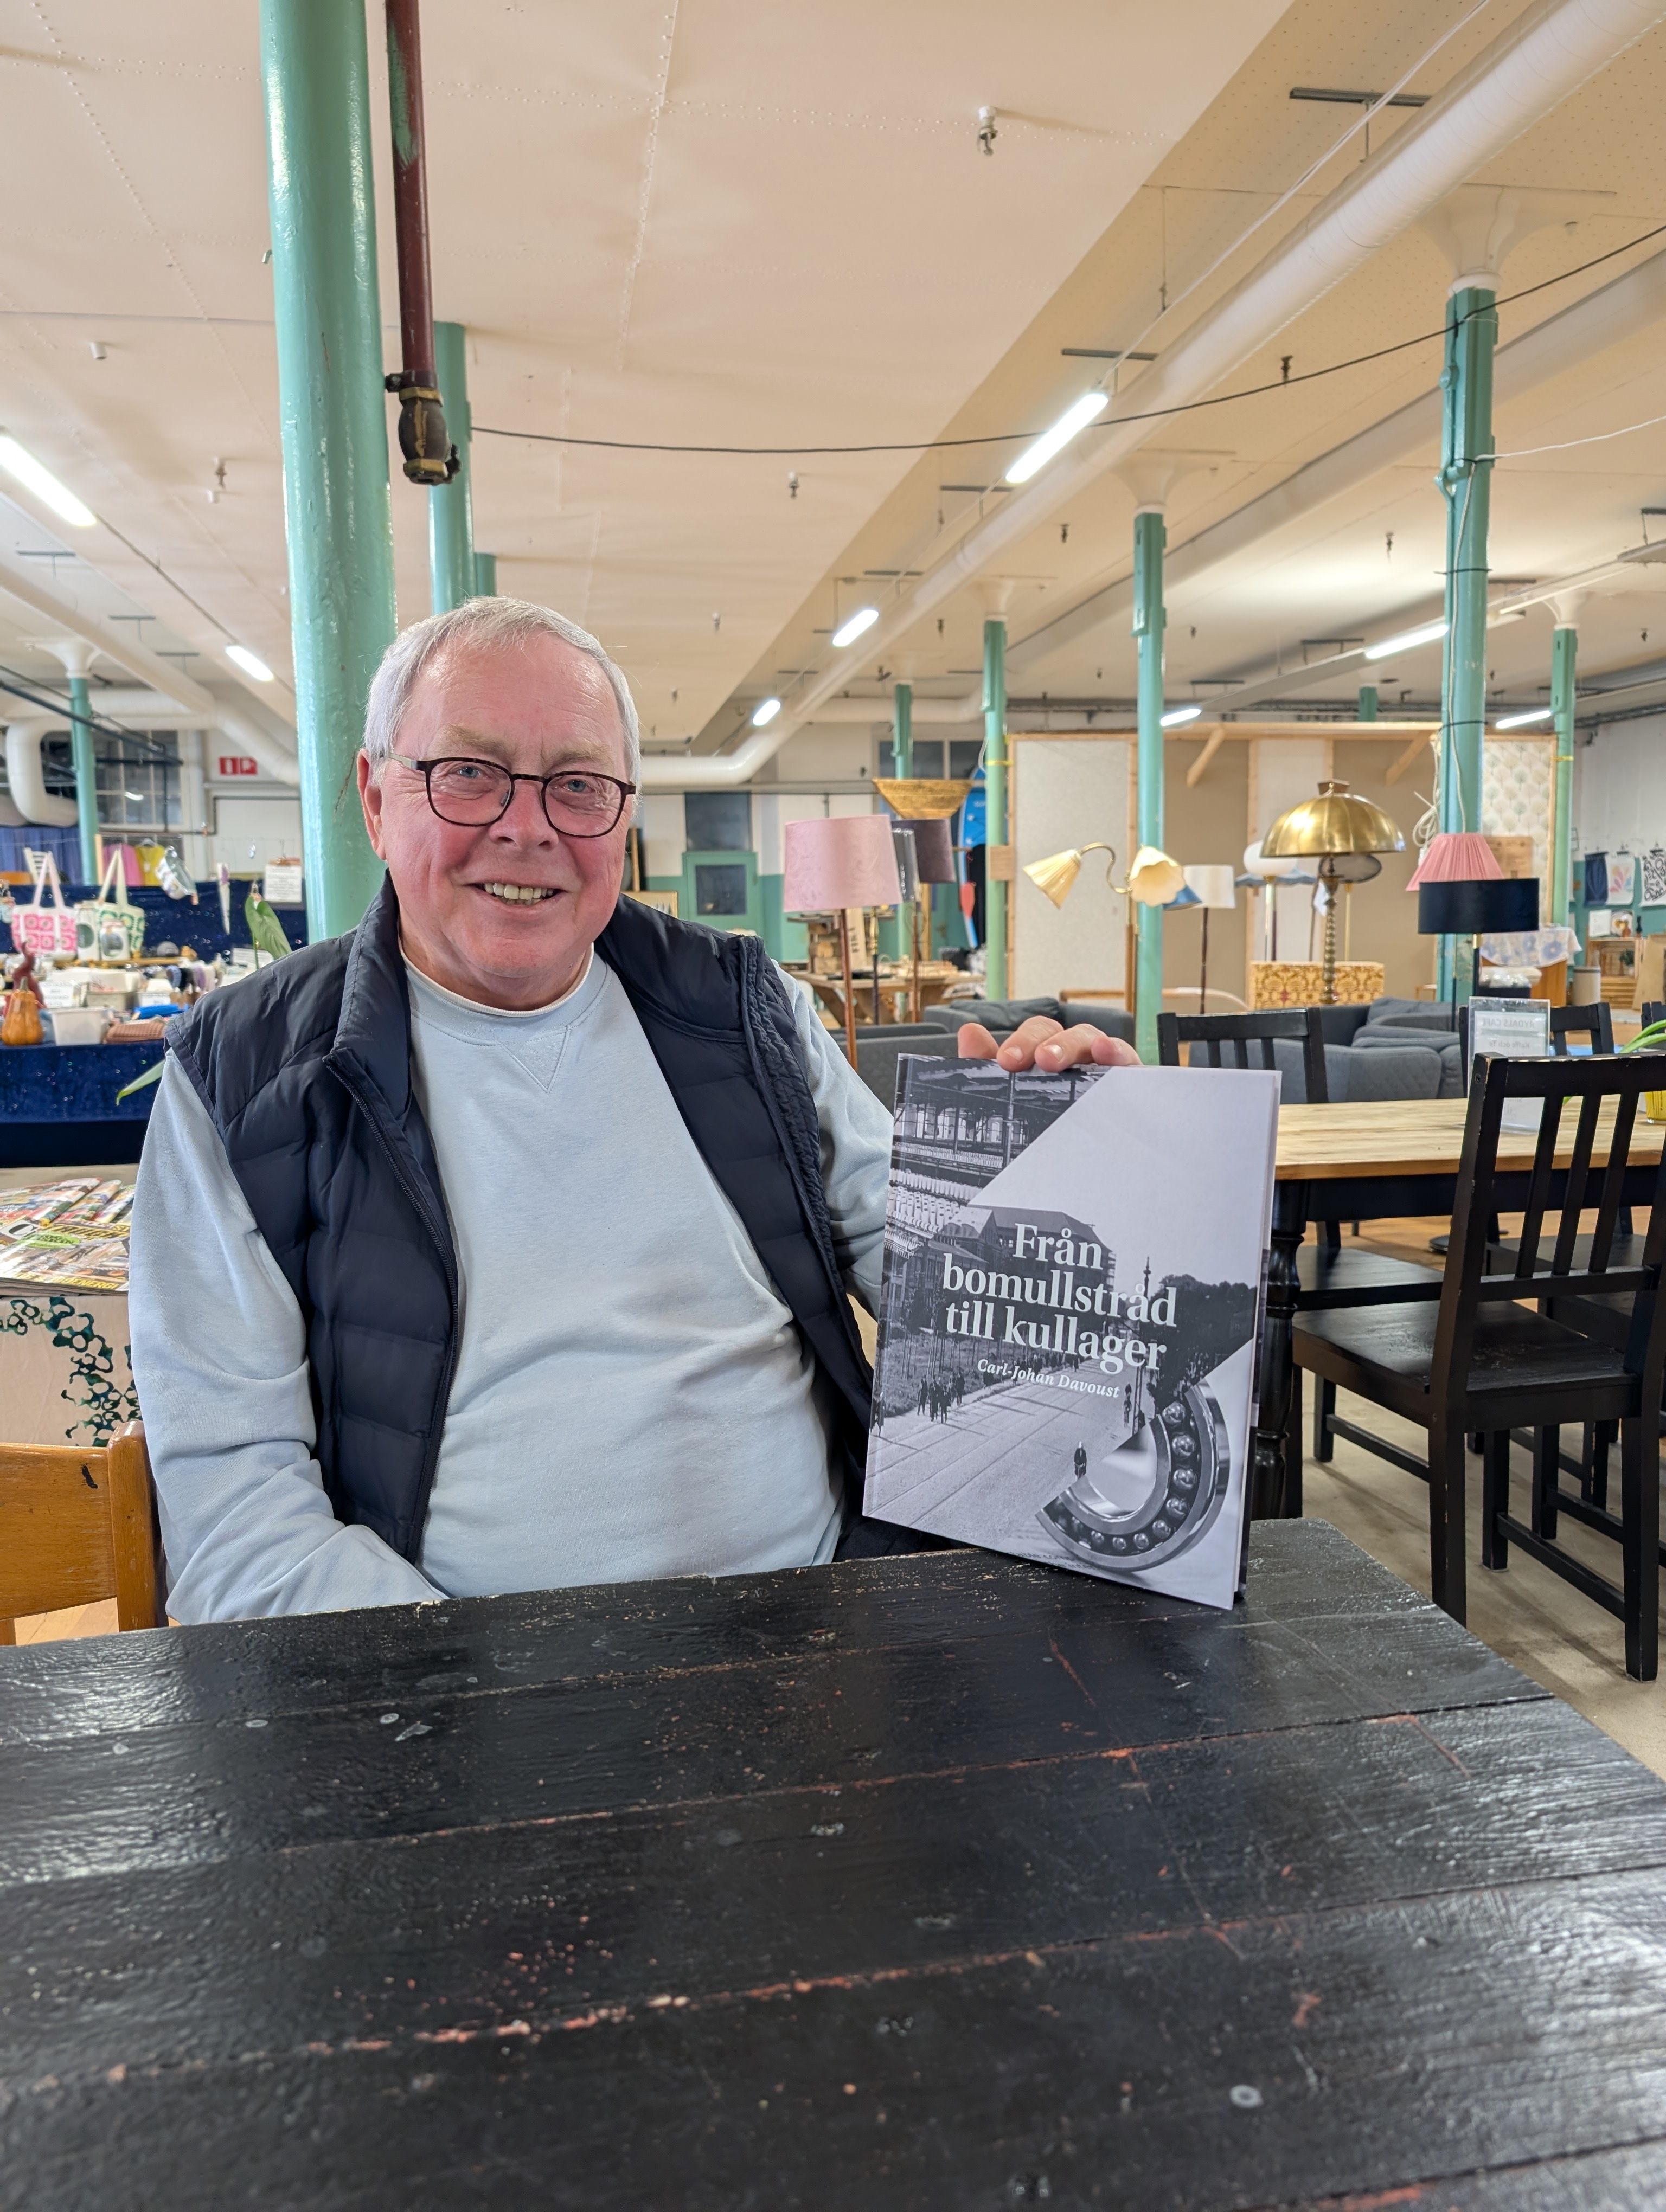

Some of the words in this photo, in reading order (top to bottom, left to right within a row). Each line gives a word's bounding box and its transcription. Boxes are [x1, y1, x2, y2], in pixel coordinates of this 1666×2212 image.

[1012, 1223, 1103, 1270] Från
[943, 1253, 1177, 1328] bomullstråd
[945, 1300, 994, 1341] till
[1002, 1305, 1167, 1375] kullager
[977, 1358, 1054, 1385] Carl-Johan
[1058, 1374, 1120, 1398] Davoust
